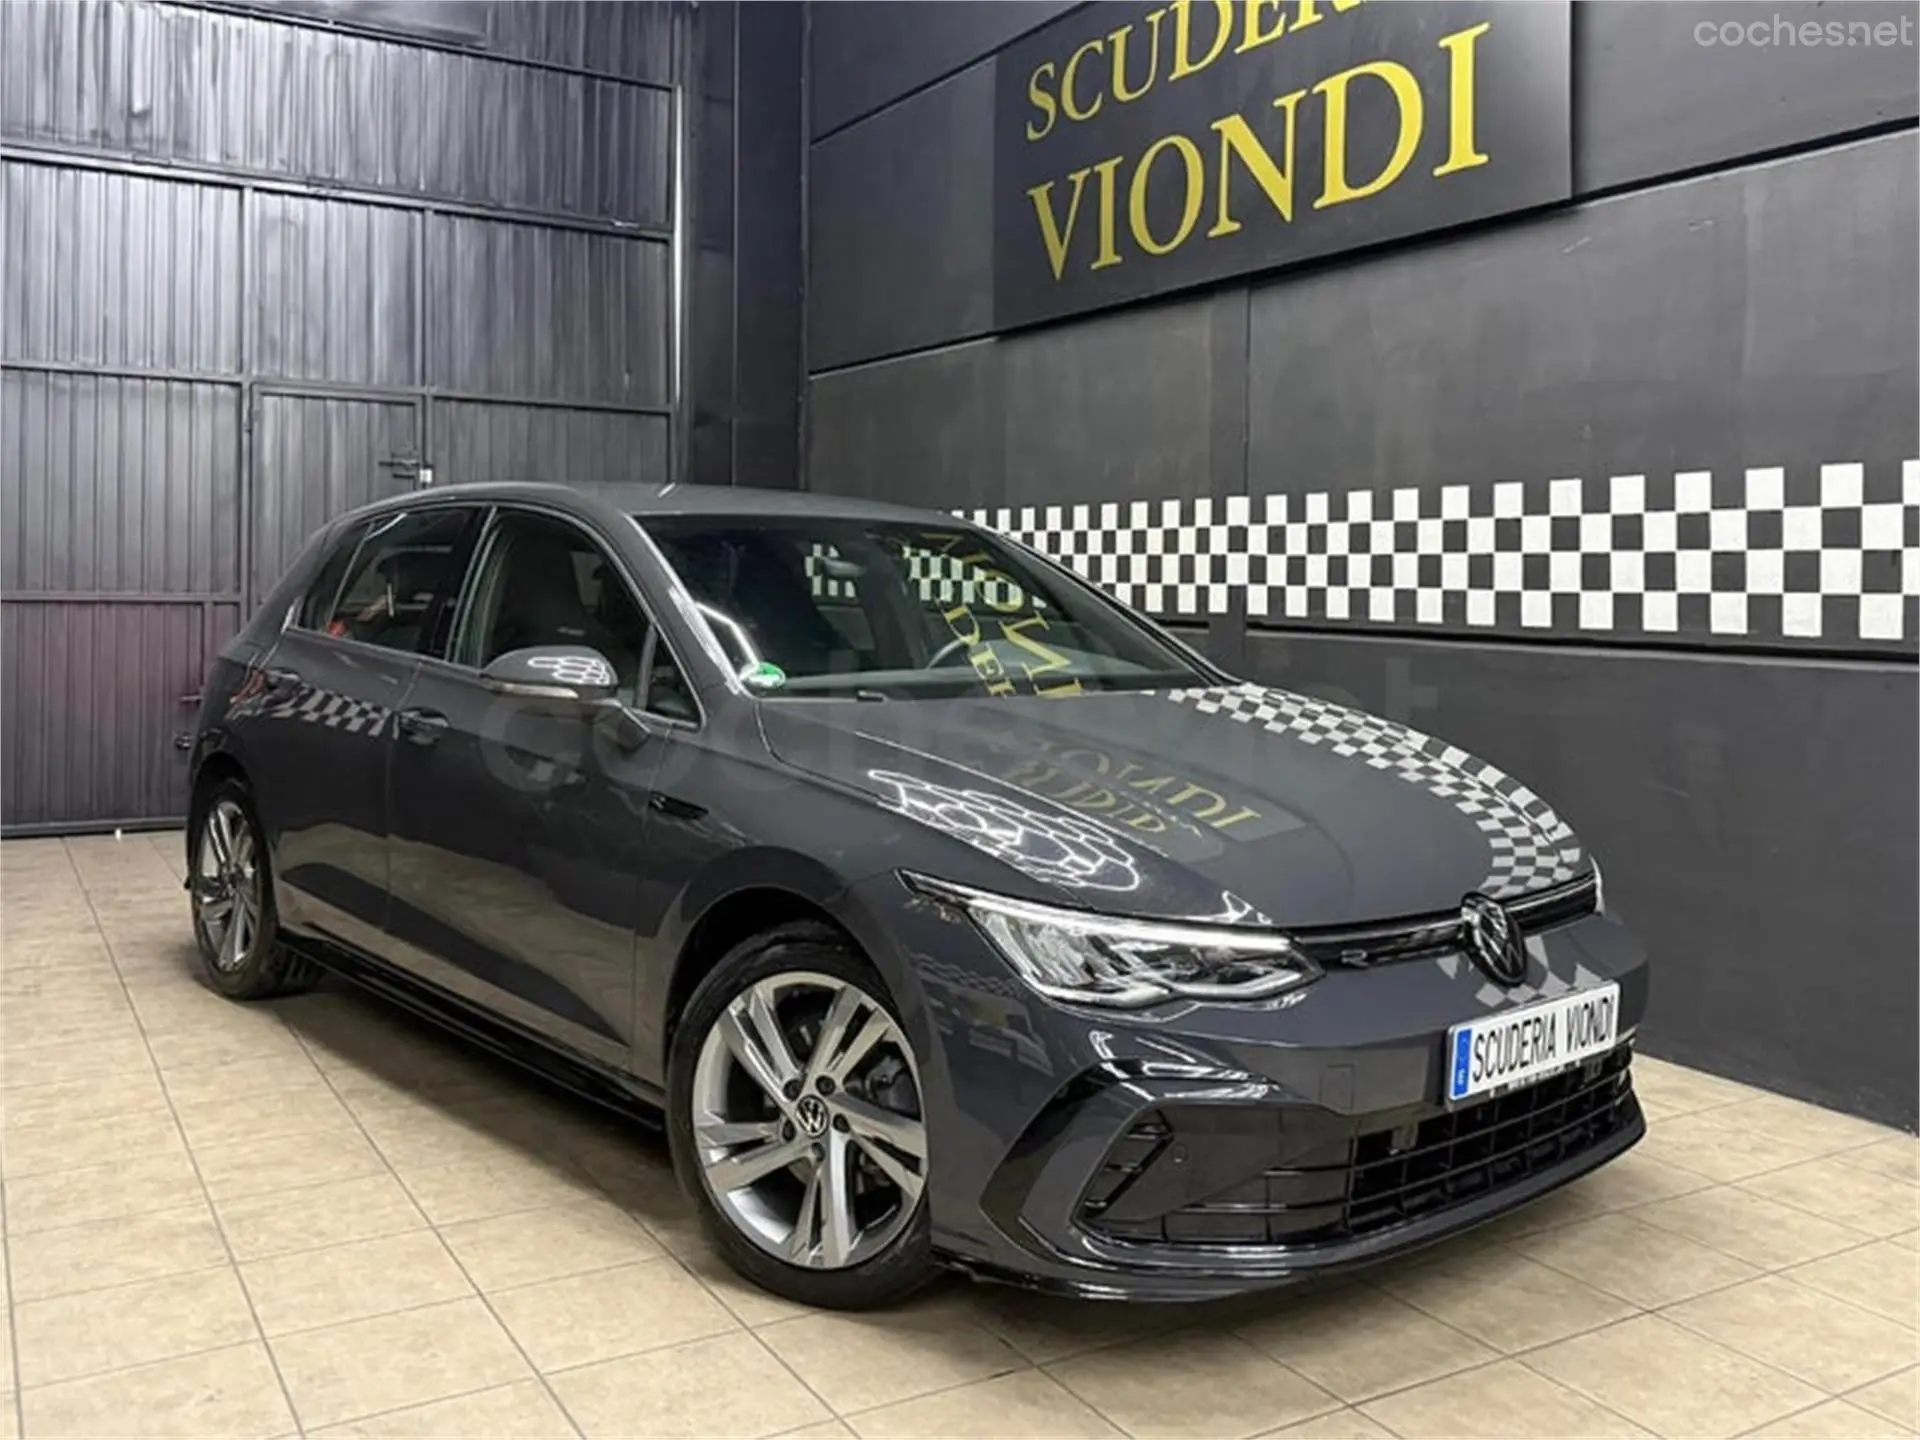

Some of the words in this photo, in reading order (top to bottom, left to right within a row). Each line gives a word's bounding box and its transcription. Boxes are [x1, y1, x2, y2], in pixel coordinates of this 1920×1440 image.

[1027, 22, 1490, 281] VIONDI
[1472, 1012, 1557, 1082] SCUDERIA
[1566, 994, 1615, 1052] VIONDI
